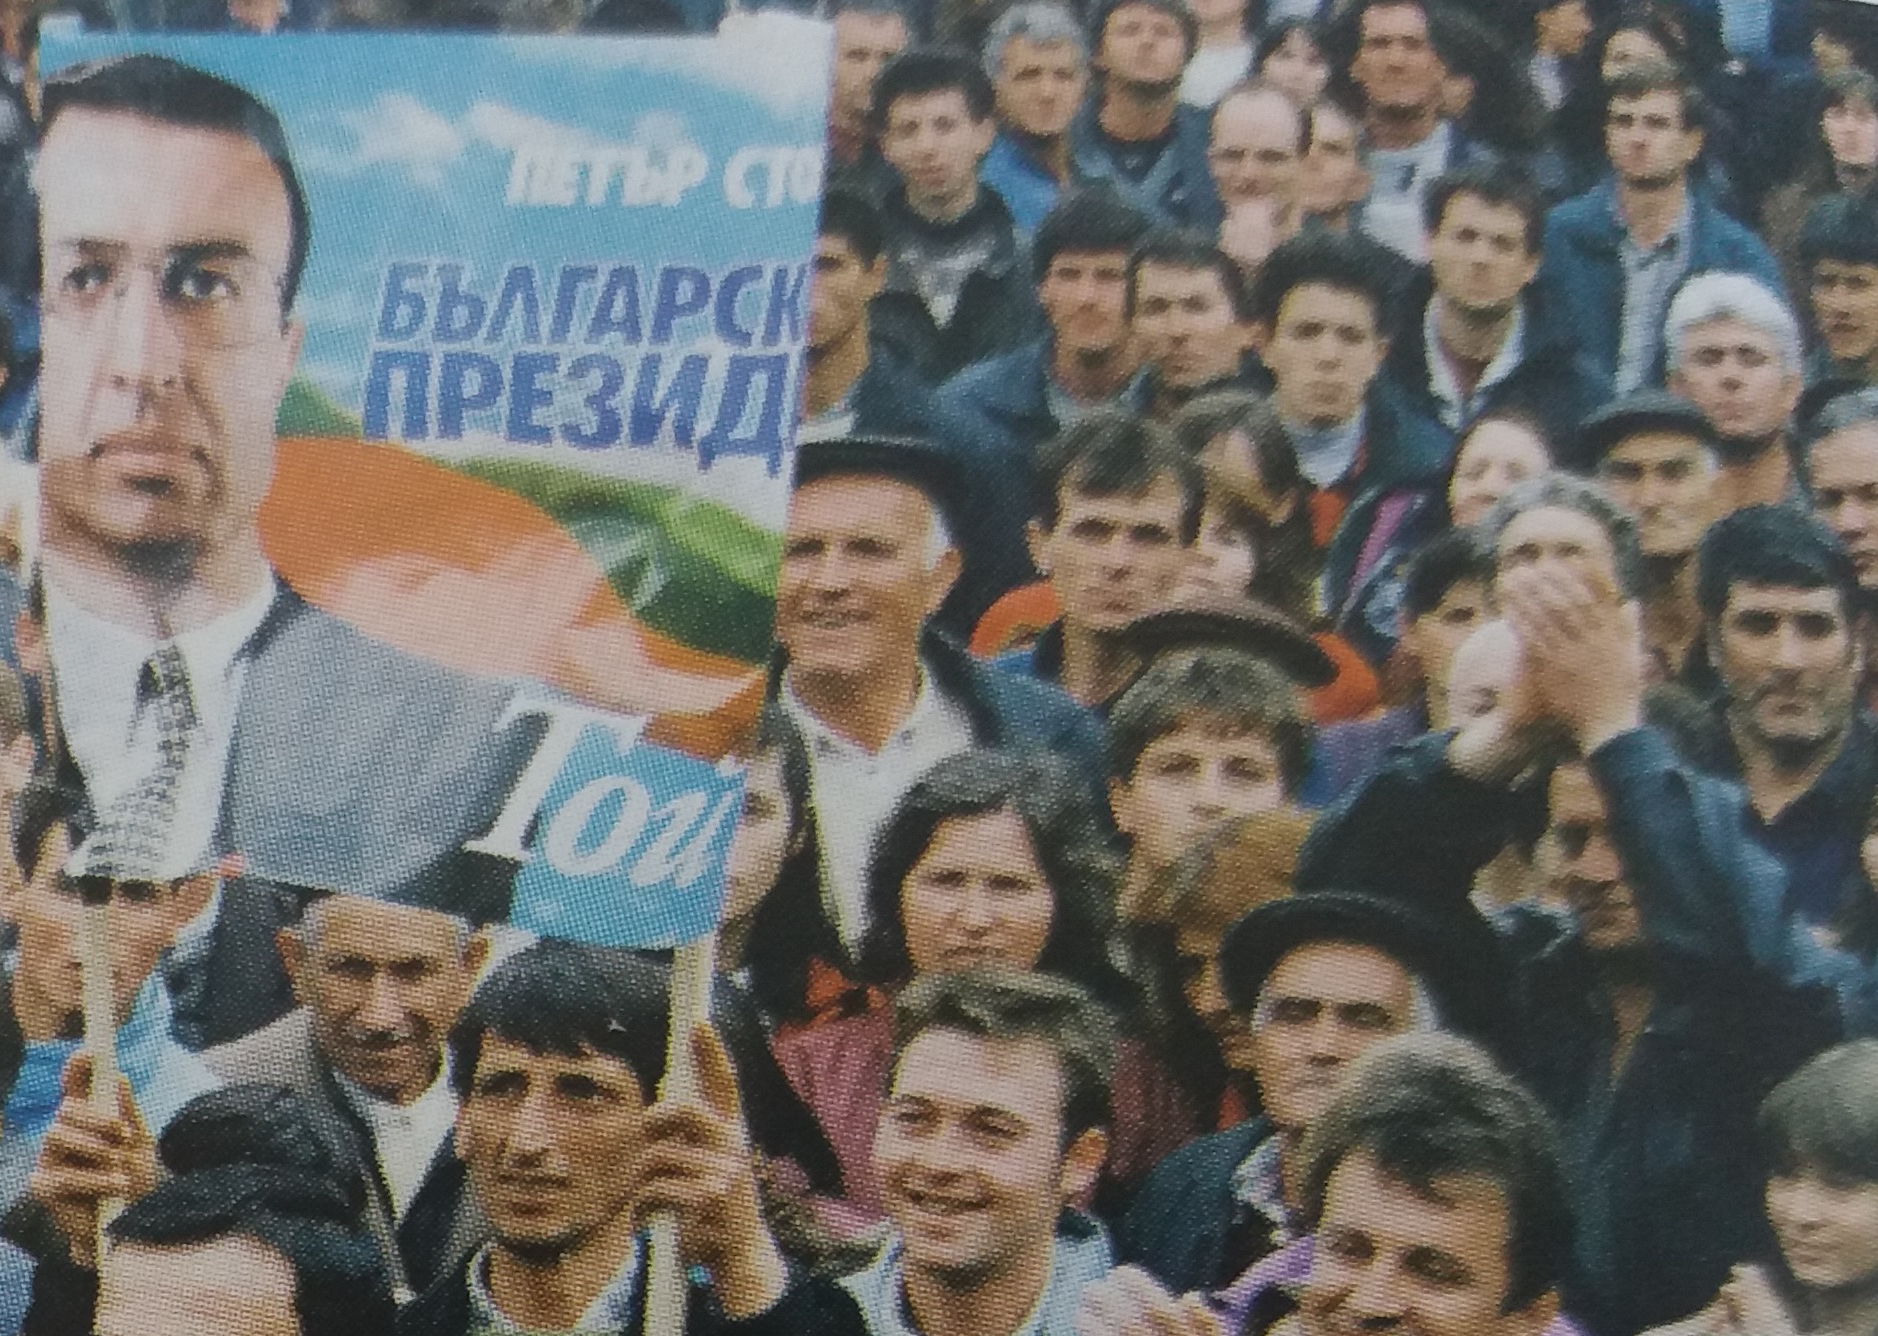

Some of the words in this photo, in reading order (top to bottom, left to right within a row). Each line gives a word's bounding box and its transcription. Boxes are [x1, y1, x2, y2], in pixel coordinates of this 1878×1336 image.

[504, 141, 709, 207] ПЕТЪР
[376, 263, 808, 347] БЪЛГАРСК
[363, 350, 790, 480] ПРЕЗИД
[462, 690, 746, 888] Той
